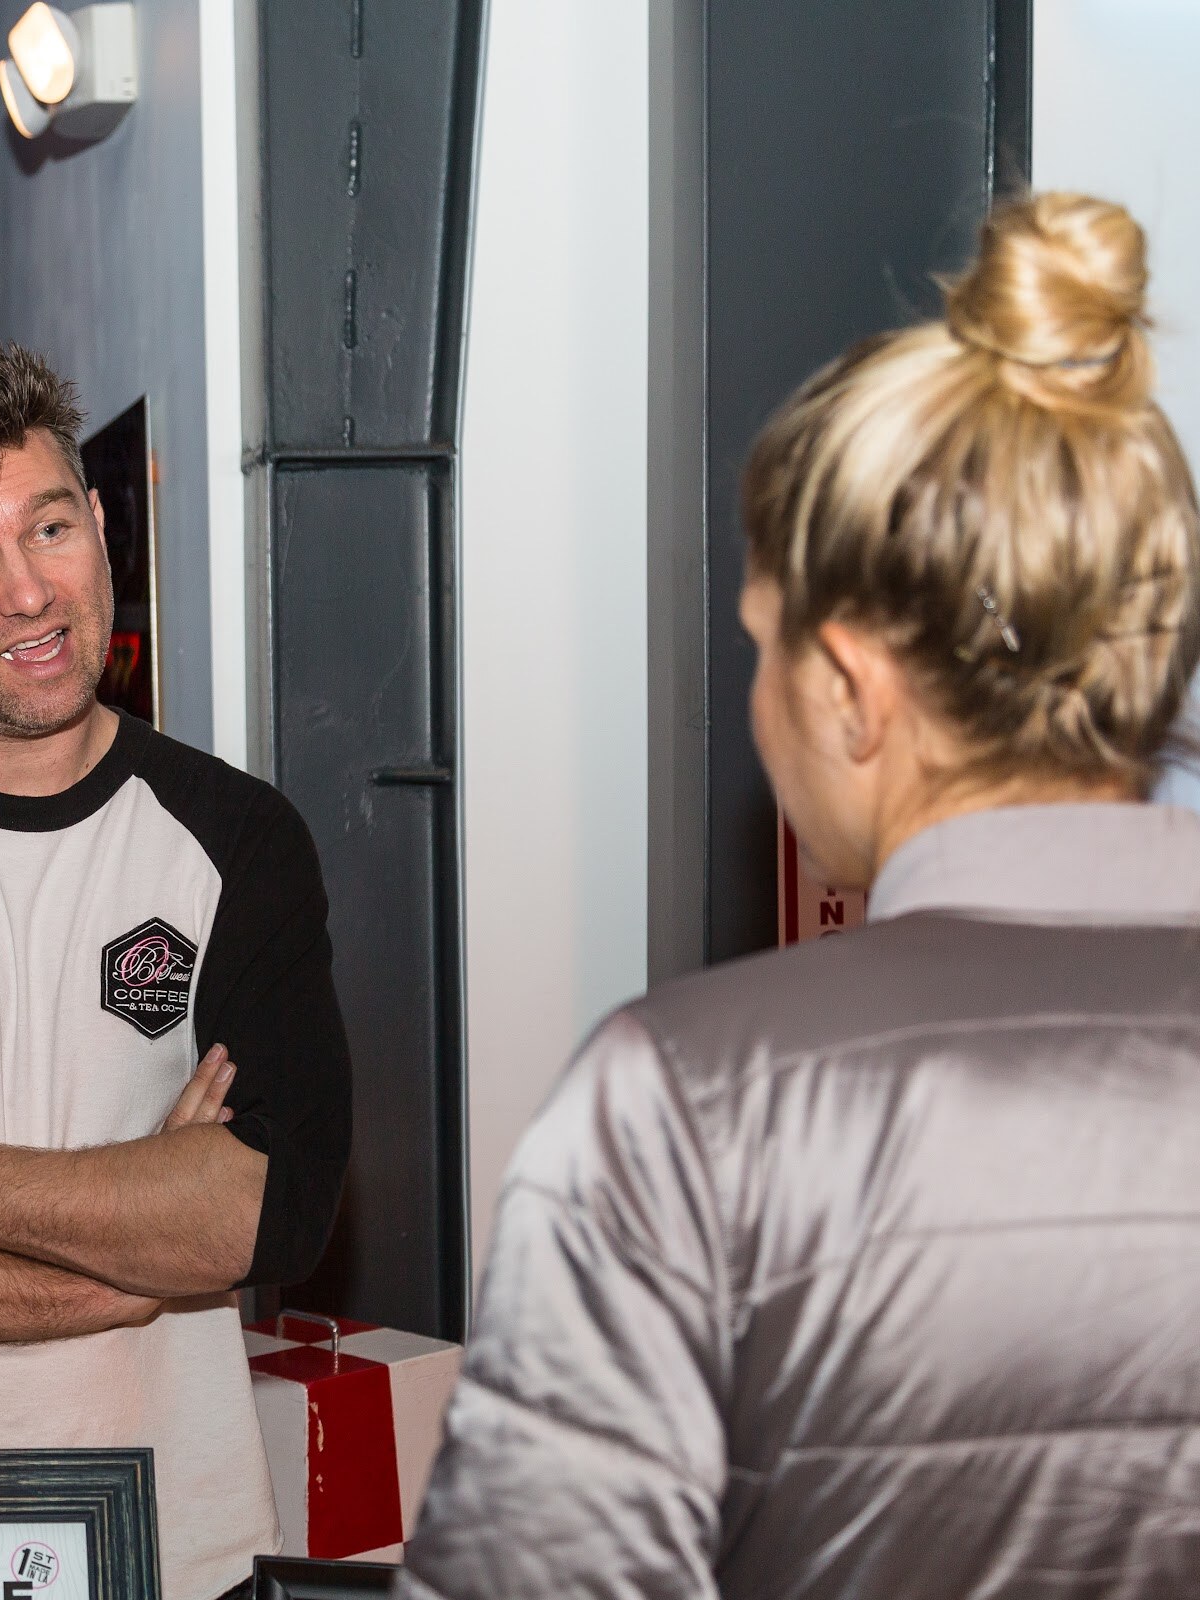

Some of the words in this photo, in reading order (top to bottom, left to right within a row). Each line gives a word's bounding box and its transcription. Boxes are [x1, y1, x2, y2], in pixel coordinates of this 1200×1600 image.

[114, 988, 189, 1003] COFFEE
[129, 1002, 138, 1011] &
[138, 1003, 159, 1012] TEA
